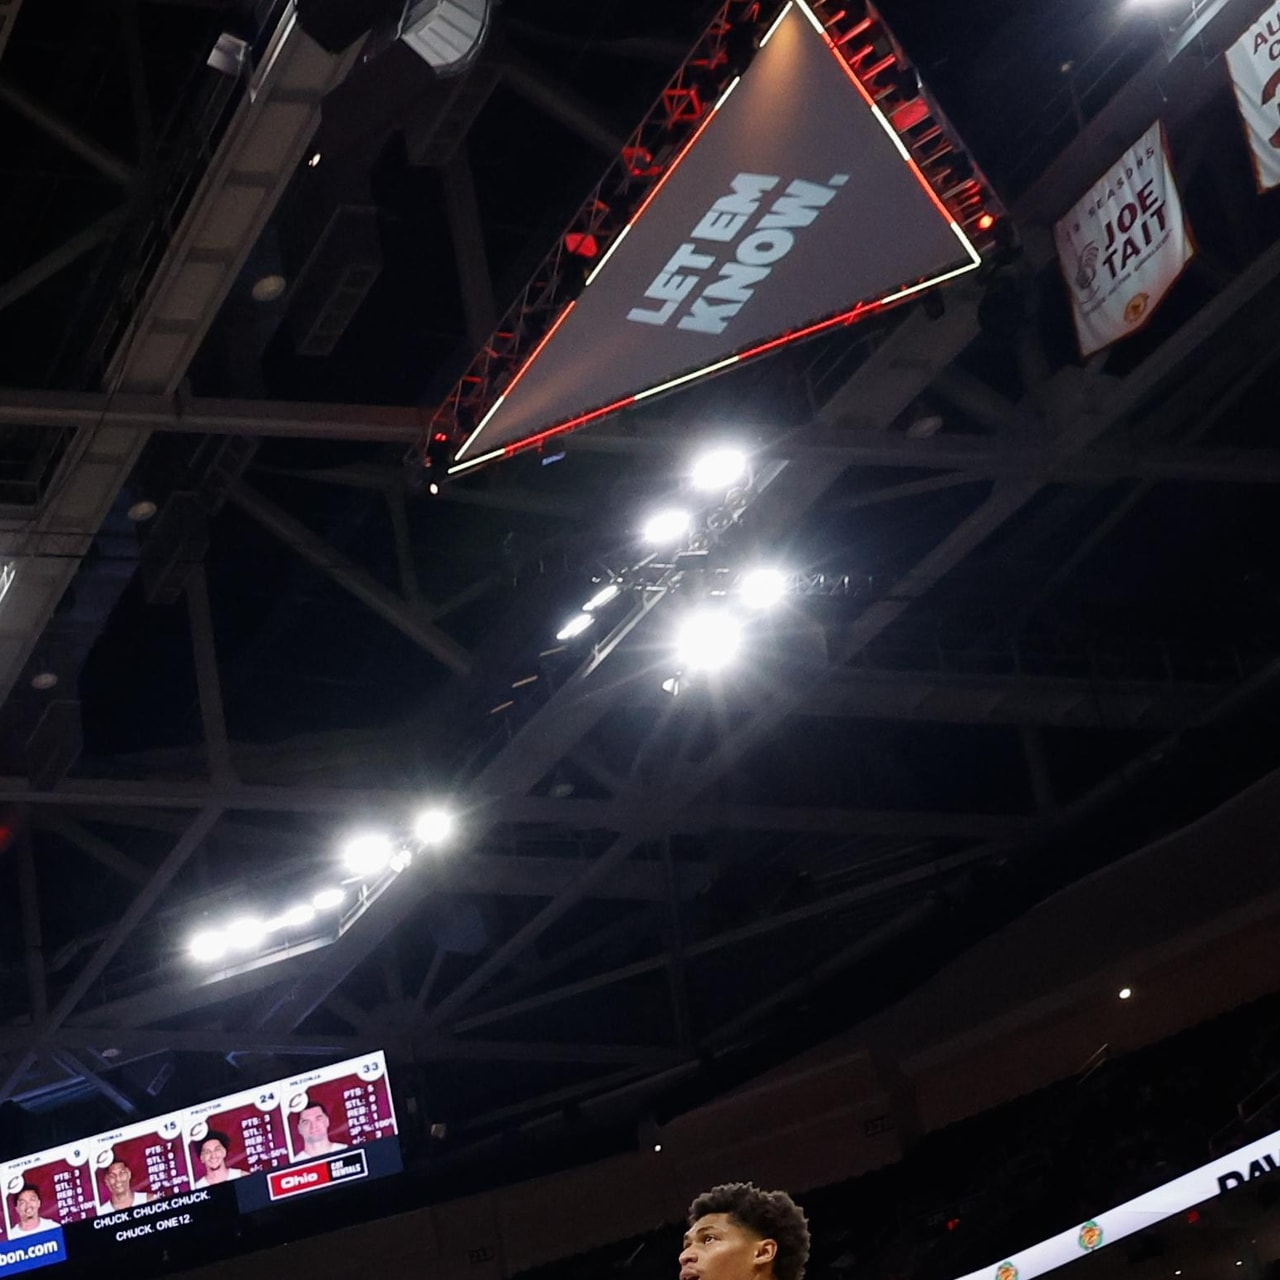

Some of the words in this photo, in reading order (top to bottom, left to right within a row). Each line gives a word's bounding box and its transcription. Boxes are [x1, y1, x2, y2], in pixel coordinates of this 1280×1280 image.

[1104, 178, 1162, 249] JOE
[1102, 200, 1168, 281] TAIT
[625, 244, 713, 327] LET
[691, 172, 783, 243] EM
[677, 173, 851, 335] KNOW.
[363, 1062, 379, 1073] 33
[259, 1093, 275, 1103] 24
[163, 1122, 177, 1131] 15
[280, 1172, 318, 1189] Ohio
[1217, 1153, 1280, 1193] DAV
[94, 1212, 132, 1229] CHUCK.
[116, 1224, 154, 1241] CHUCK.
